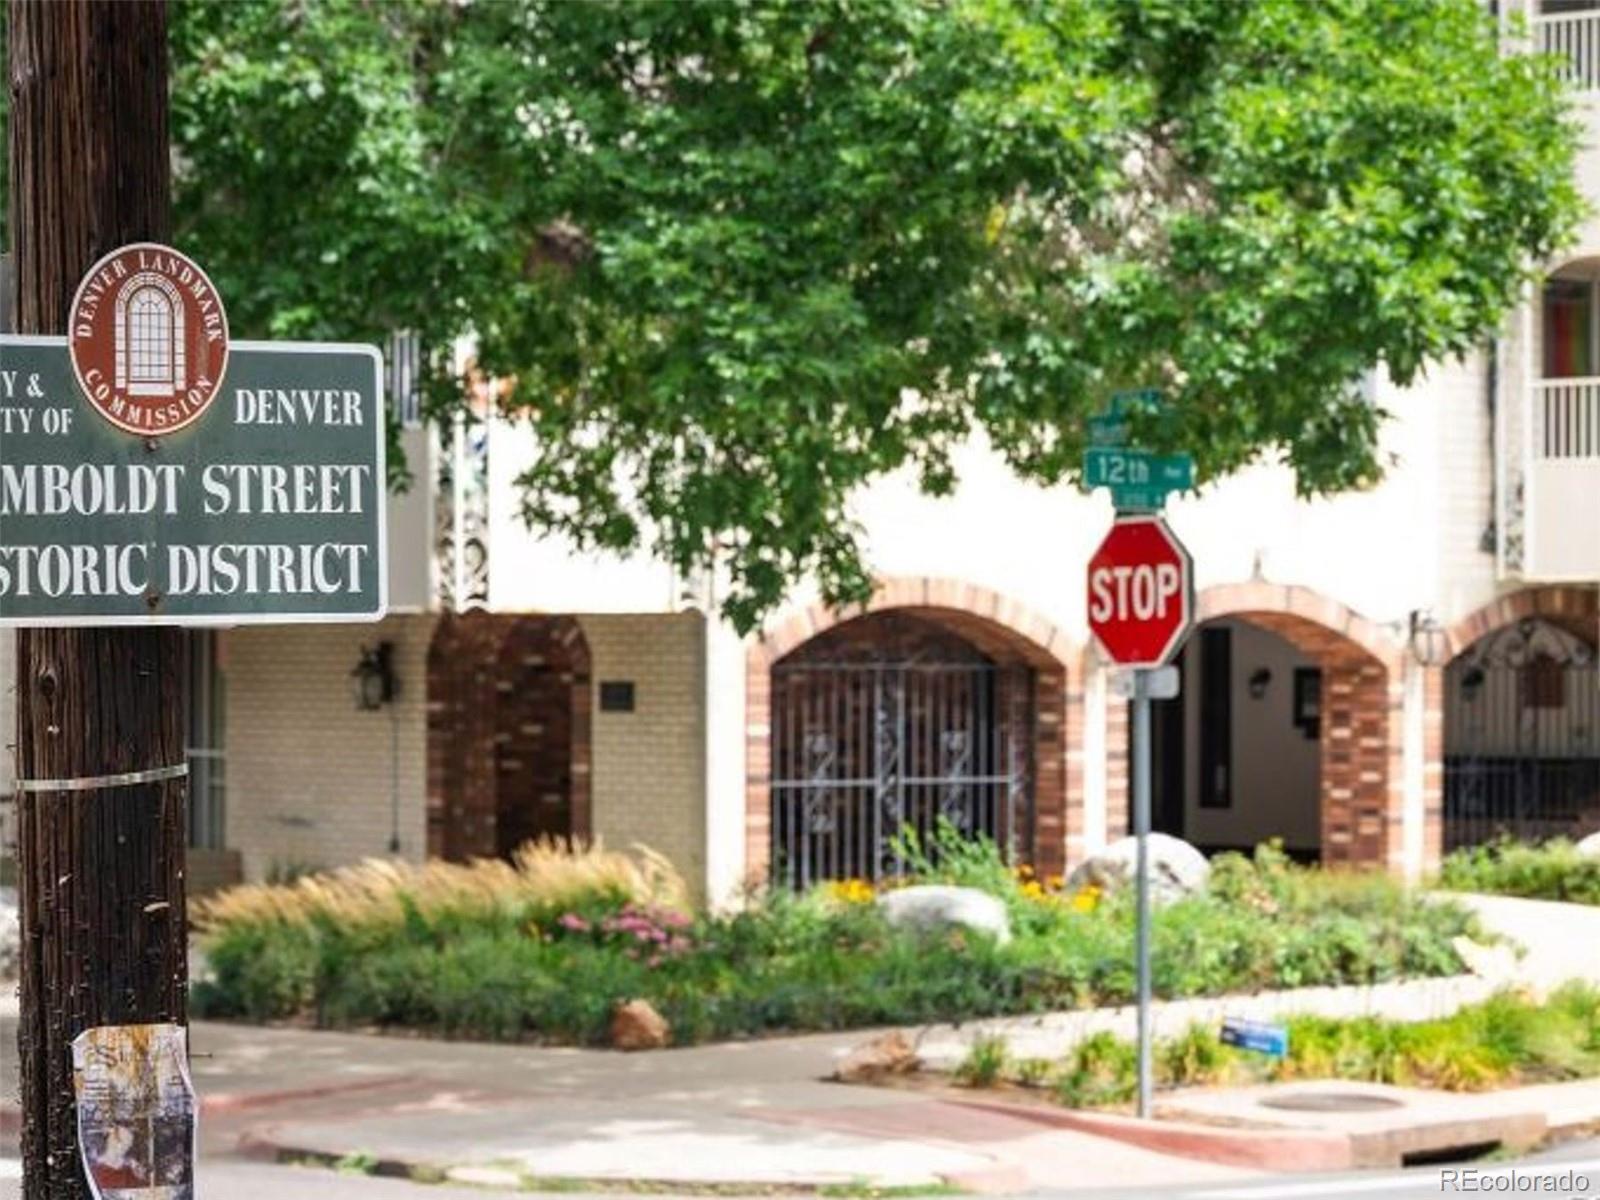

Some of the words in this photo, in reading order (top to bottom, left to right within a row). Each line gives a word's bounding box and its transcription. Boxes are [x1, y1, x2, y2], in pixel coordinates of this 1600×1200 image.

[77, 259, 127, 338] DENVER
[139, 251, 222, 342] LANDMARK
[26, 373, 45, 398] &
[85, 368, 213, 427] COMMISSION
[234, 389, 363, 426] DENVER
[42, 406, 74, 435] OF
[202, 464, 370, 515] STREET
[1099, 455, 1149, 484] 12th
[167, 543, 367, 596] DISTRICT
[1092, 563, 1179, 623] STOP
